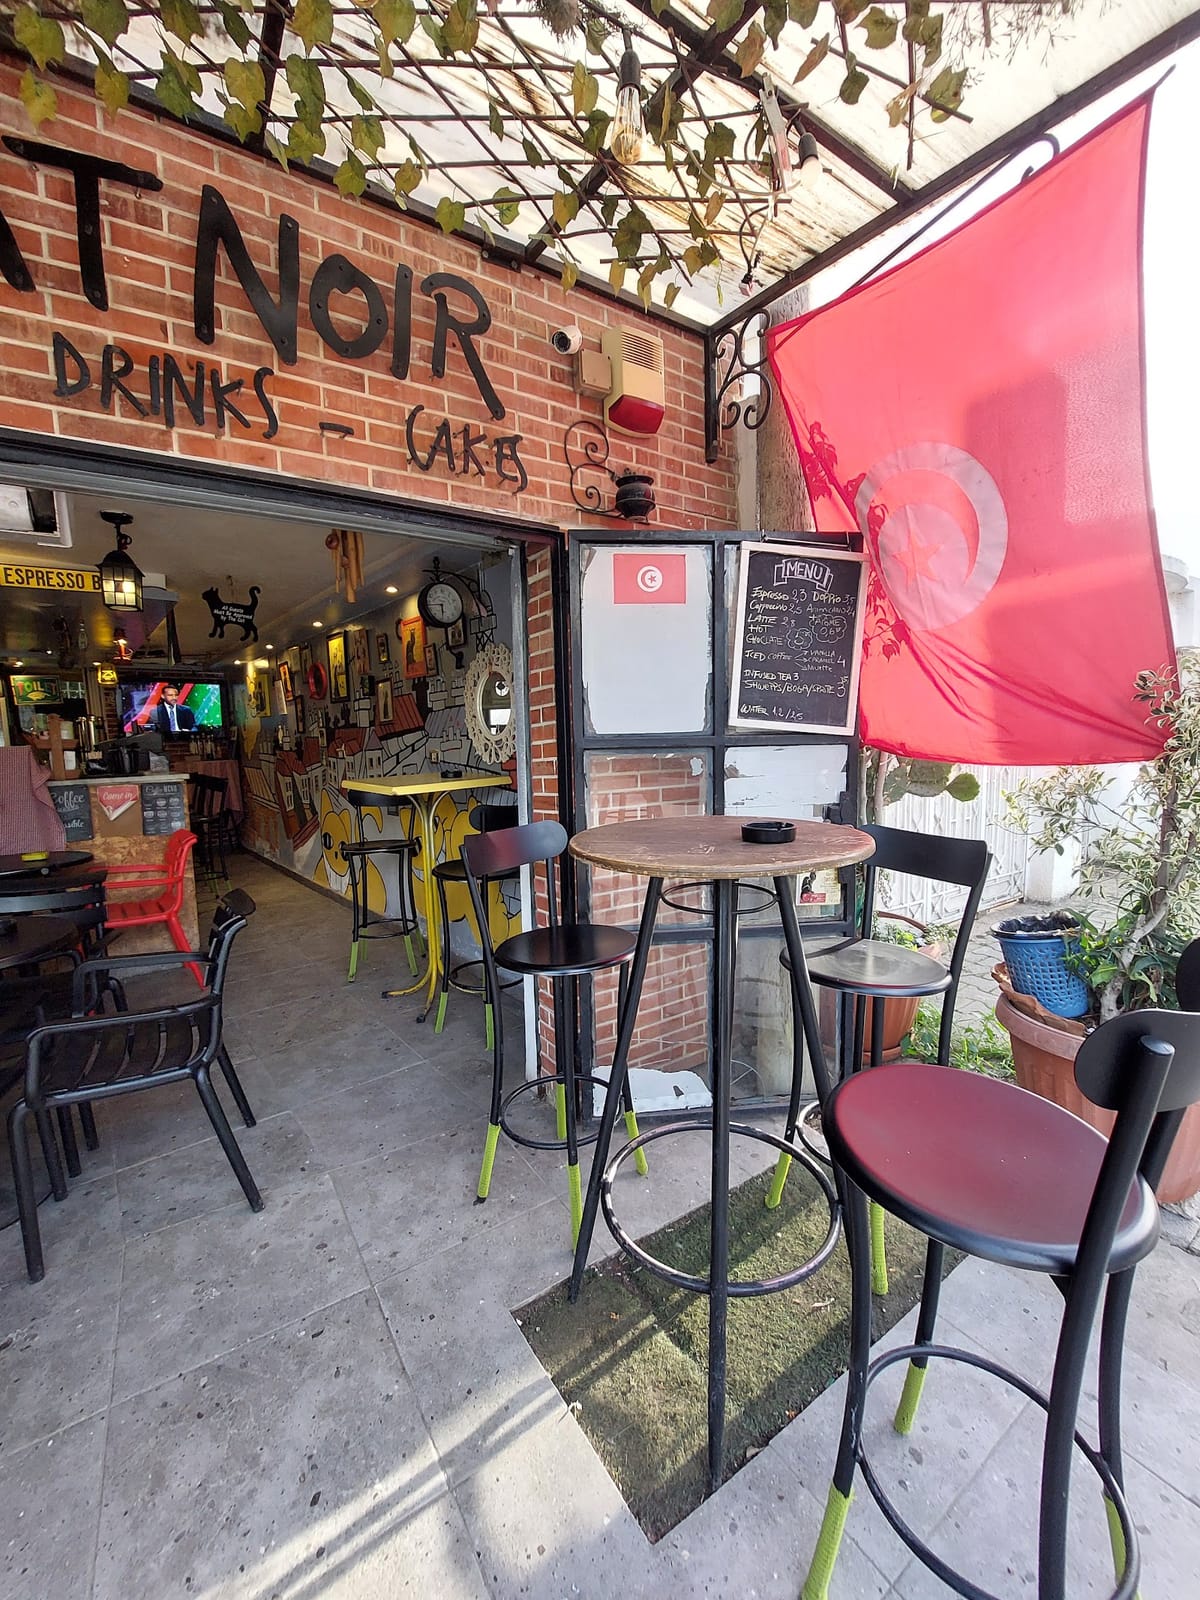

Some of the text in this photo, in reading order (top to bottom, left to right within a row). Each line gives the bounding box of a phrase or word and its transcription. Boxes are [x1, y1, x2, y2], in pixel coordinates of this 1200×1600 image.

[194, 184, 507, 421] NOIR
[52, 331, 279, 438] DRINKS
[3, 567, 102, 591] ESPRESSO B
[786, 560, 824, 580] MENU
[792, 672, 800, 681] 3
